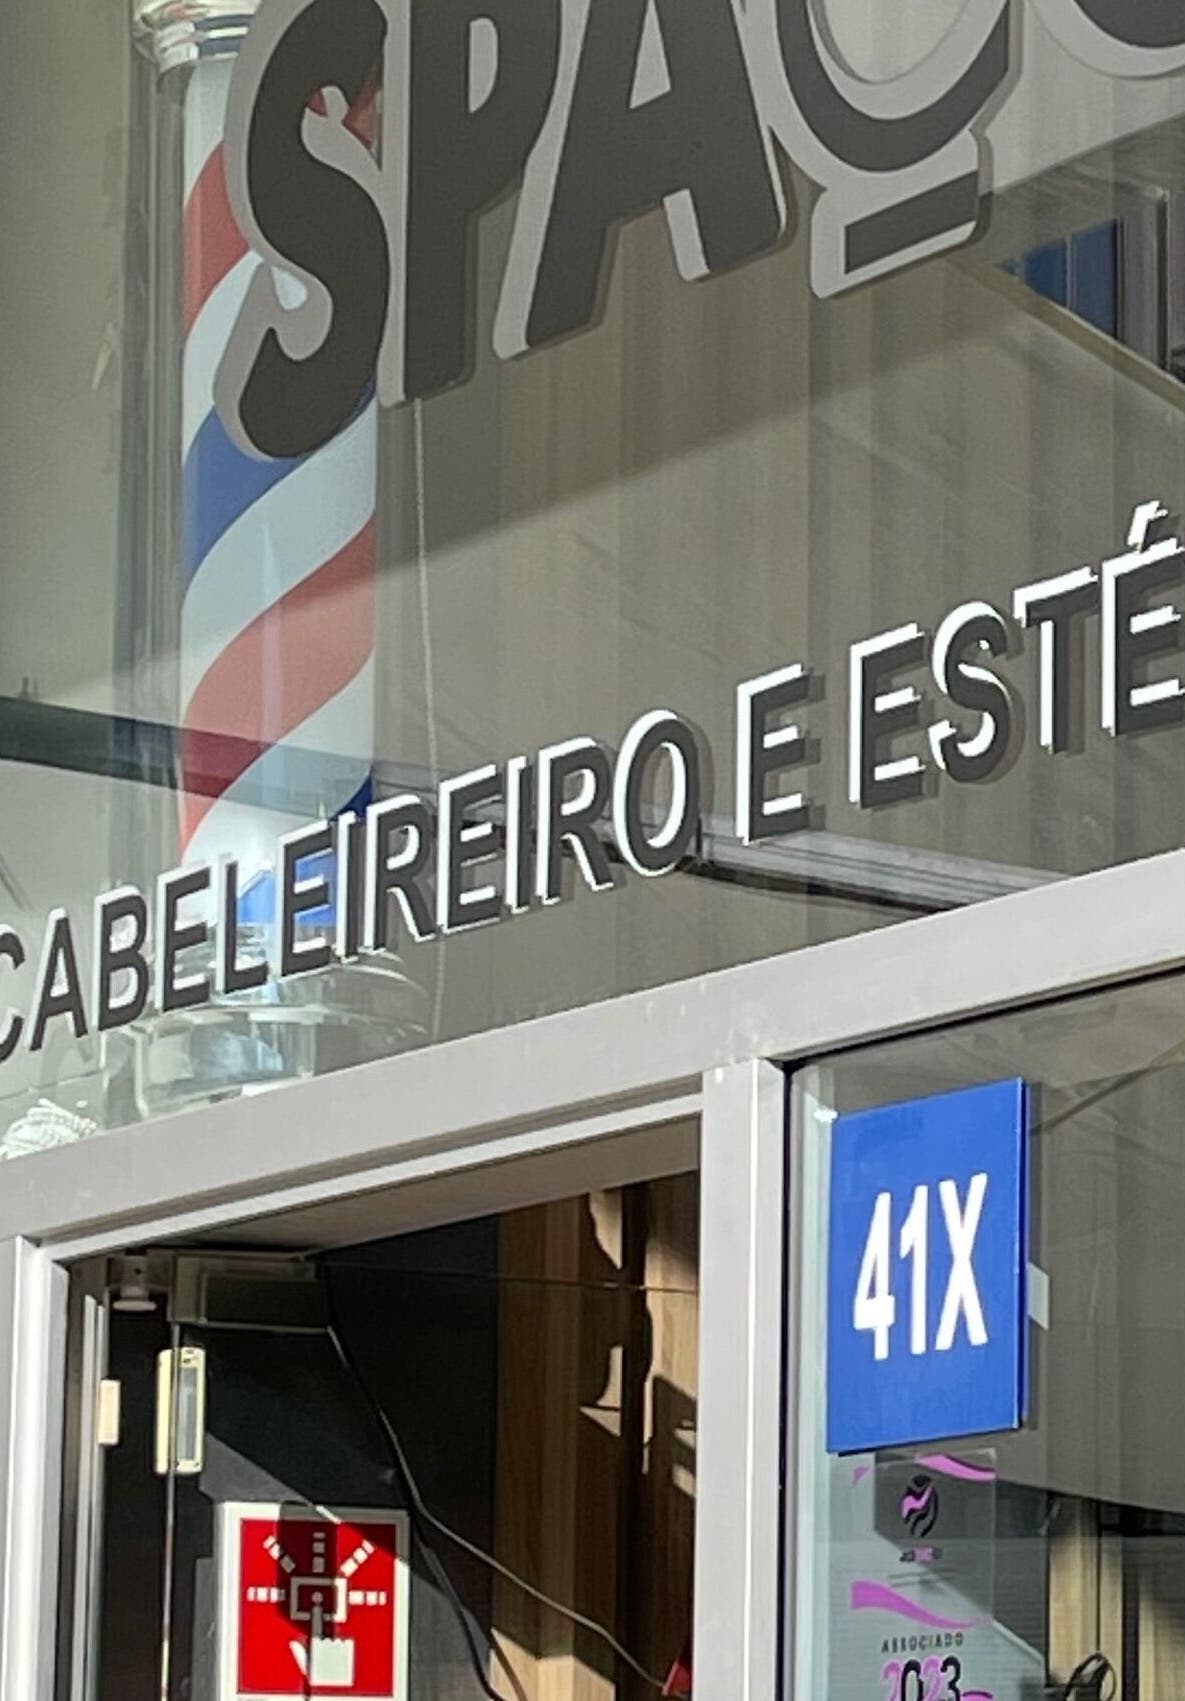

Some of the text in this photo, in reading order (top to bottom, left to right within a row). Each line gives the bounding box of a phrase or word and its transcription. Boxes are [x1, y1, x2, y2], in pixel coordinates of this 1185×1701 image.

[735, 663, 807, 846] E
[851, 1171, 989, 1363] 41X
[881, 1631, 964, 1653] ASSOCIADO
